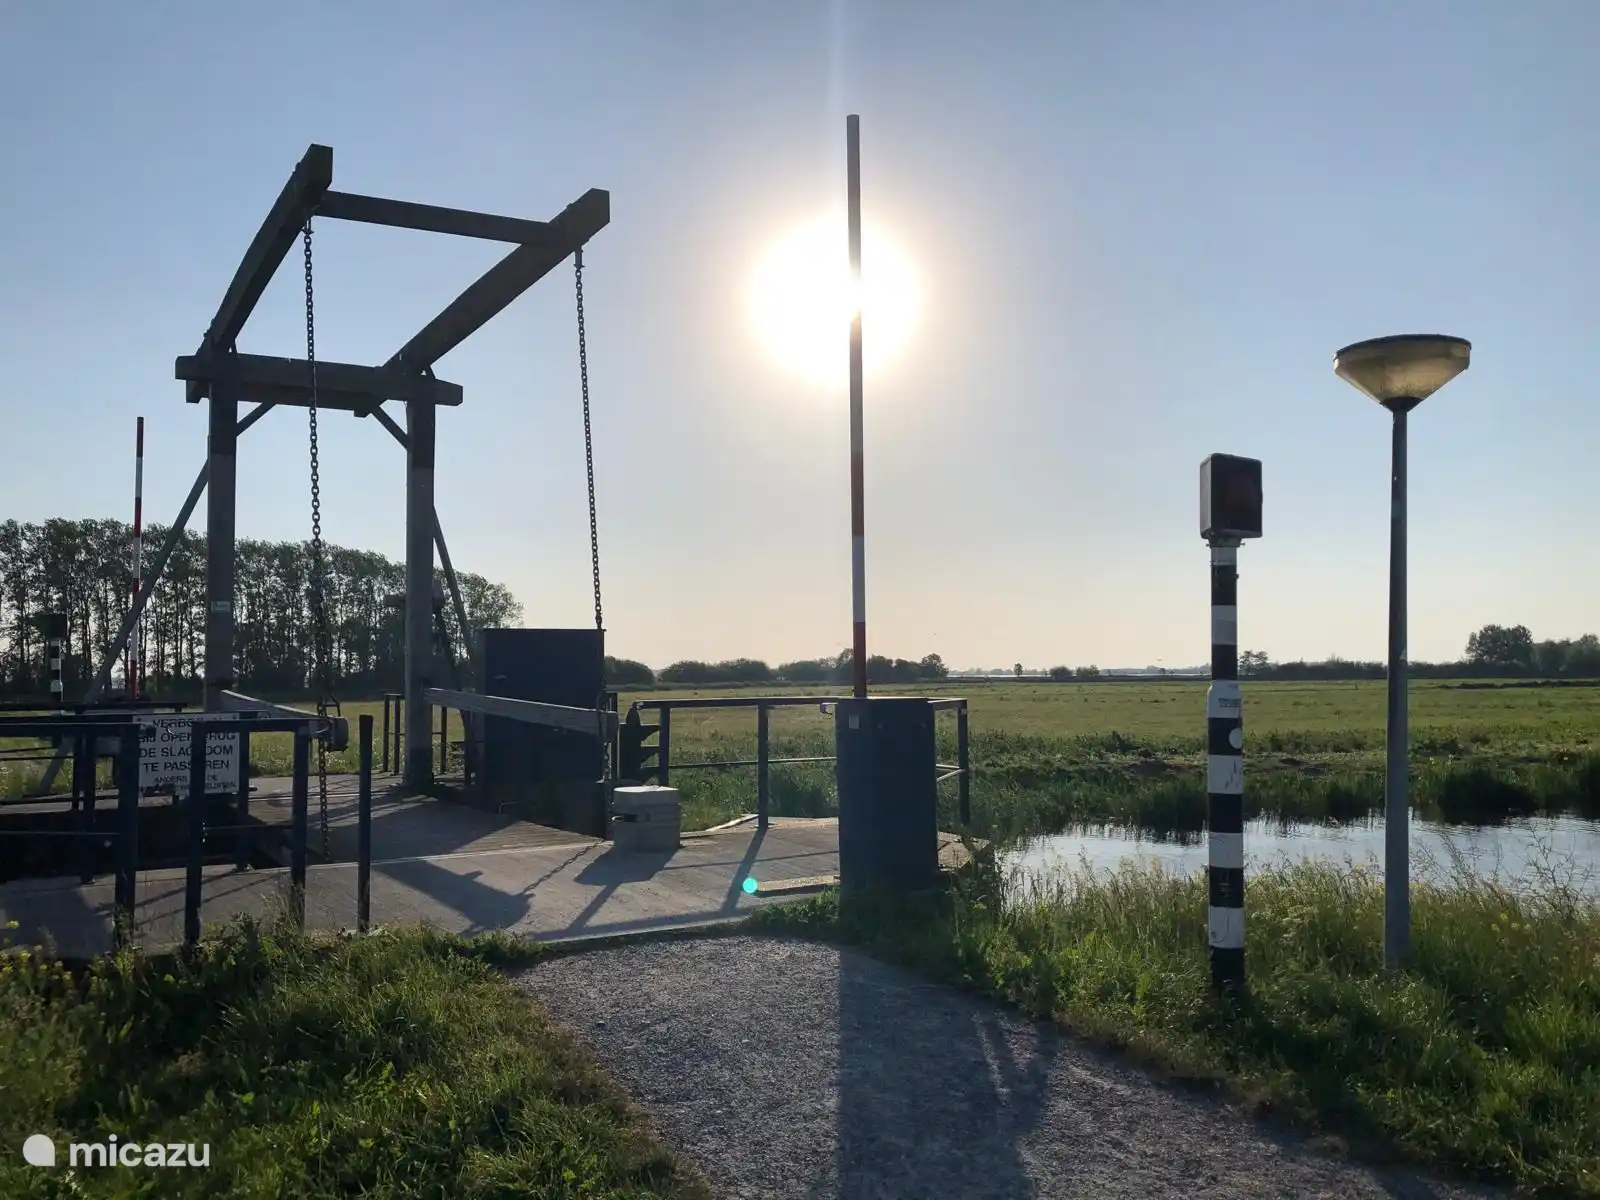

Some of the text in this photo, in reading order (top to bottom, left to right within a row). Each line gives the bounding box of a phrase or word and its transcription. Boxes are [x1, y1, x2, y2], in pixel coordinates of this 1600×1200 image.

[203, 731, 236, 741] RUG
[139, 744, 233, 758] DE SLAGOOM
[144, 760, 229, 773] TE PASSREN
